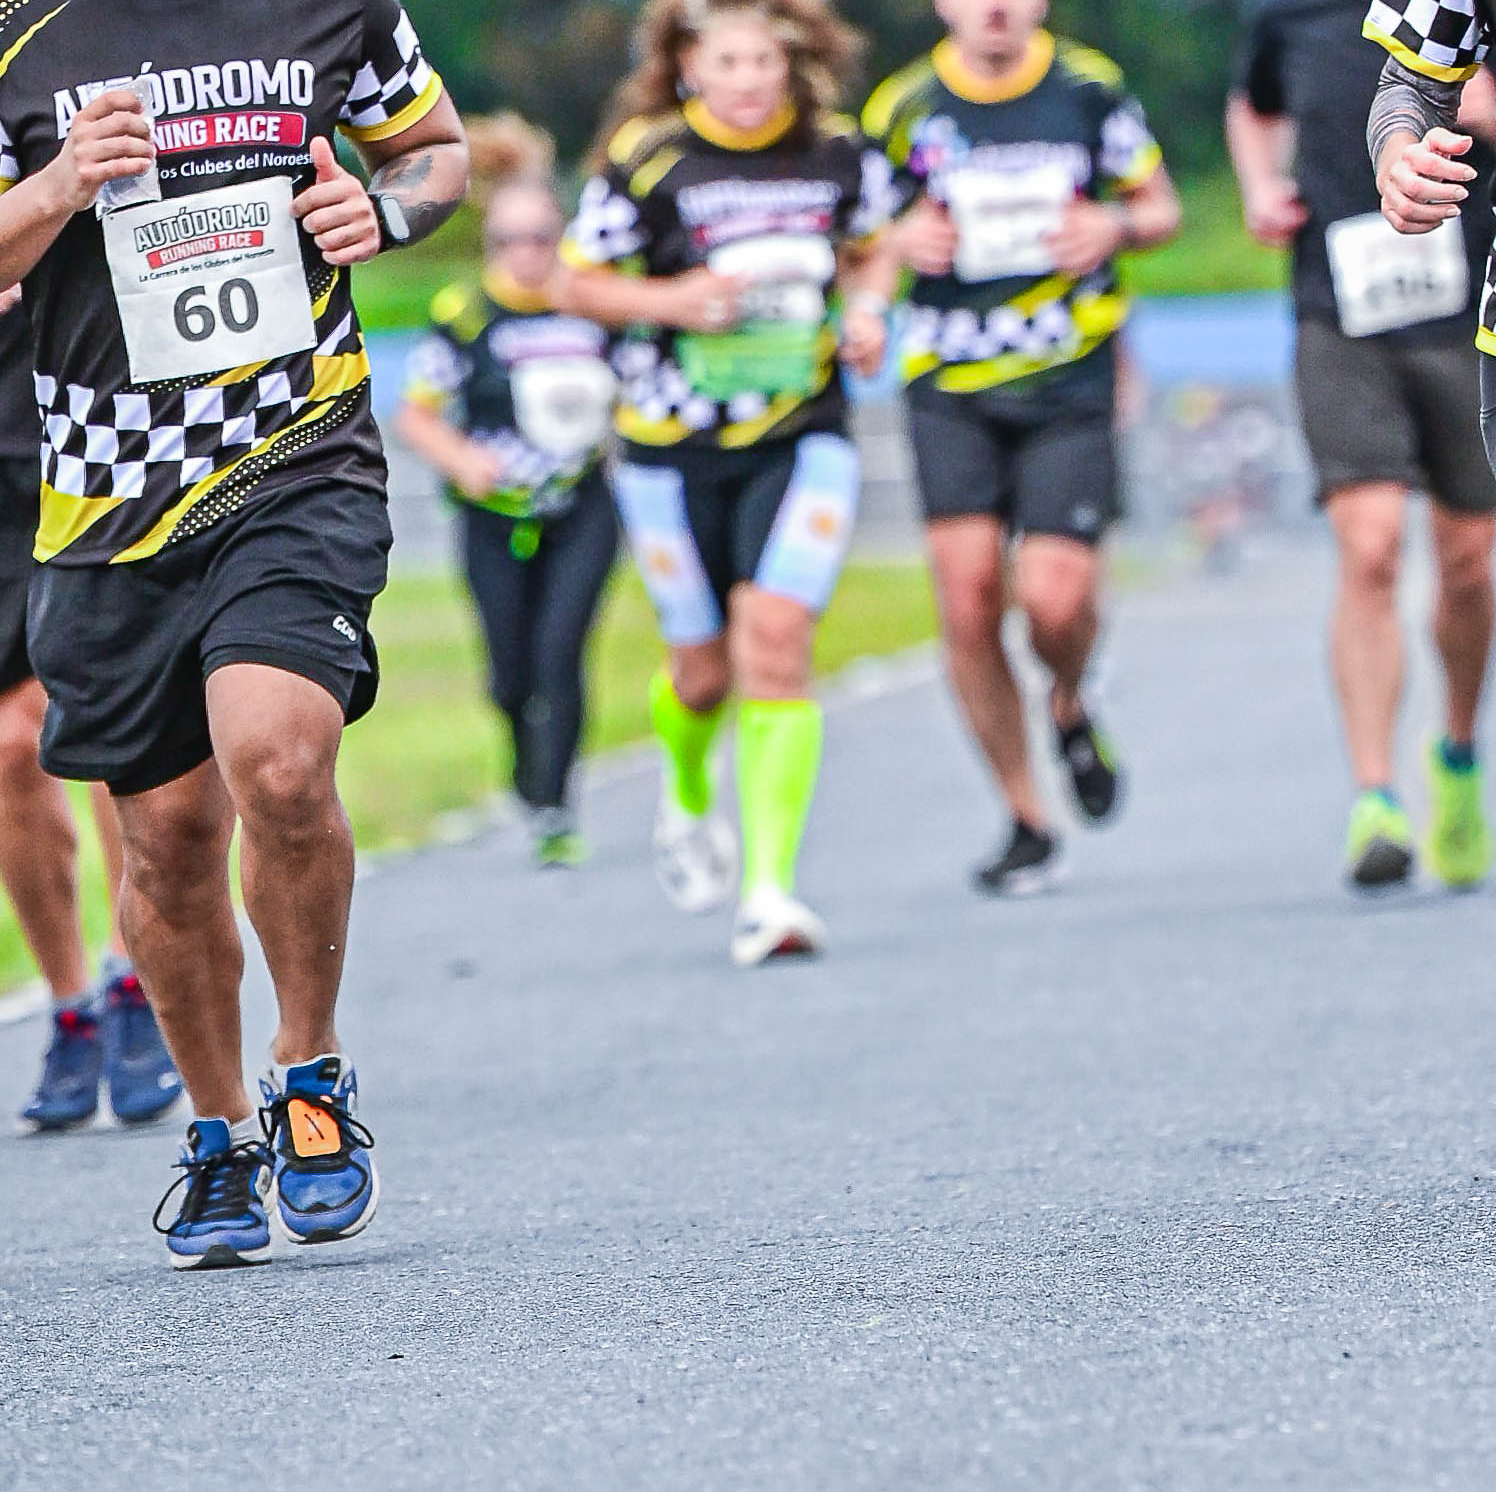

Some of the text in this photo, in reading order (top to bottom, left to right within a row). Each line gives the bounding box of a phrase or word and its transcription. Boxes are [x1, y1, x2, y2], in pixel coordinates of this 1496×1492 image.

[53, 59, 316, 140] AÓDROMO
[154, 114, 281, 152] NING RACE
[160, 167, 177, 179] os
[180, 159, 233, 177] Clubes
[234, 153, 260, 171] del
[133, 202, 270, 253] AUTÓDROMO
[159, 233, 252, 265] RUNNING RACE
[139, 274, 148, 283] La
[149, 269, 178, 280] Carrera
[174, 278, 259, 342] 60
